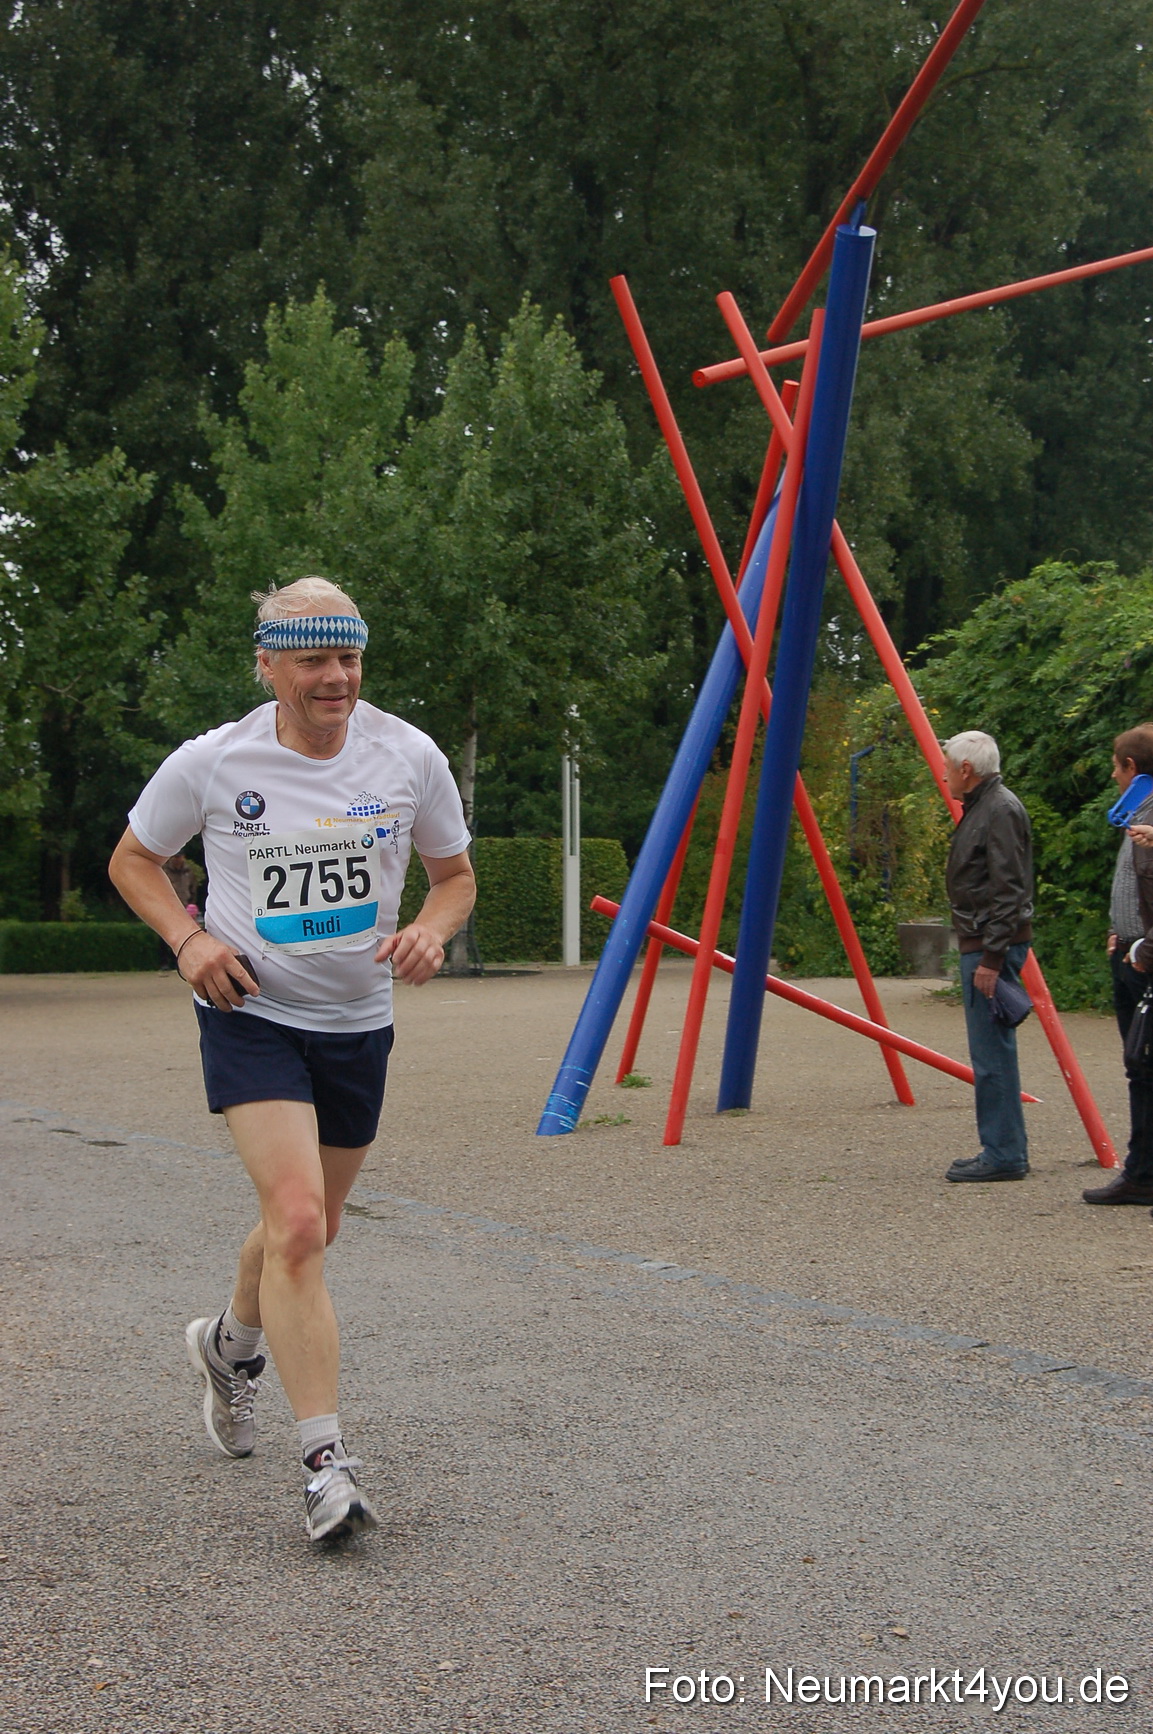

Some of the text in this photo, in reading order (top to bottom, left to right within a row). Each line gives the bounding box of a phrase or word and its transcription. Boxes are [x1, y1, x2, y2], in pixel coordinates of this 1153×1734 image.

[233, 820, 271, 831] PARTL
[249, 839, 357, 860] PARTL Neumarkt
[263, 855, 371, 910] 2755
[302, 915, 341, 937] Rudi
